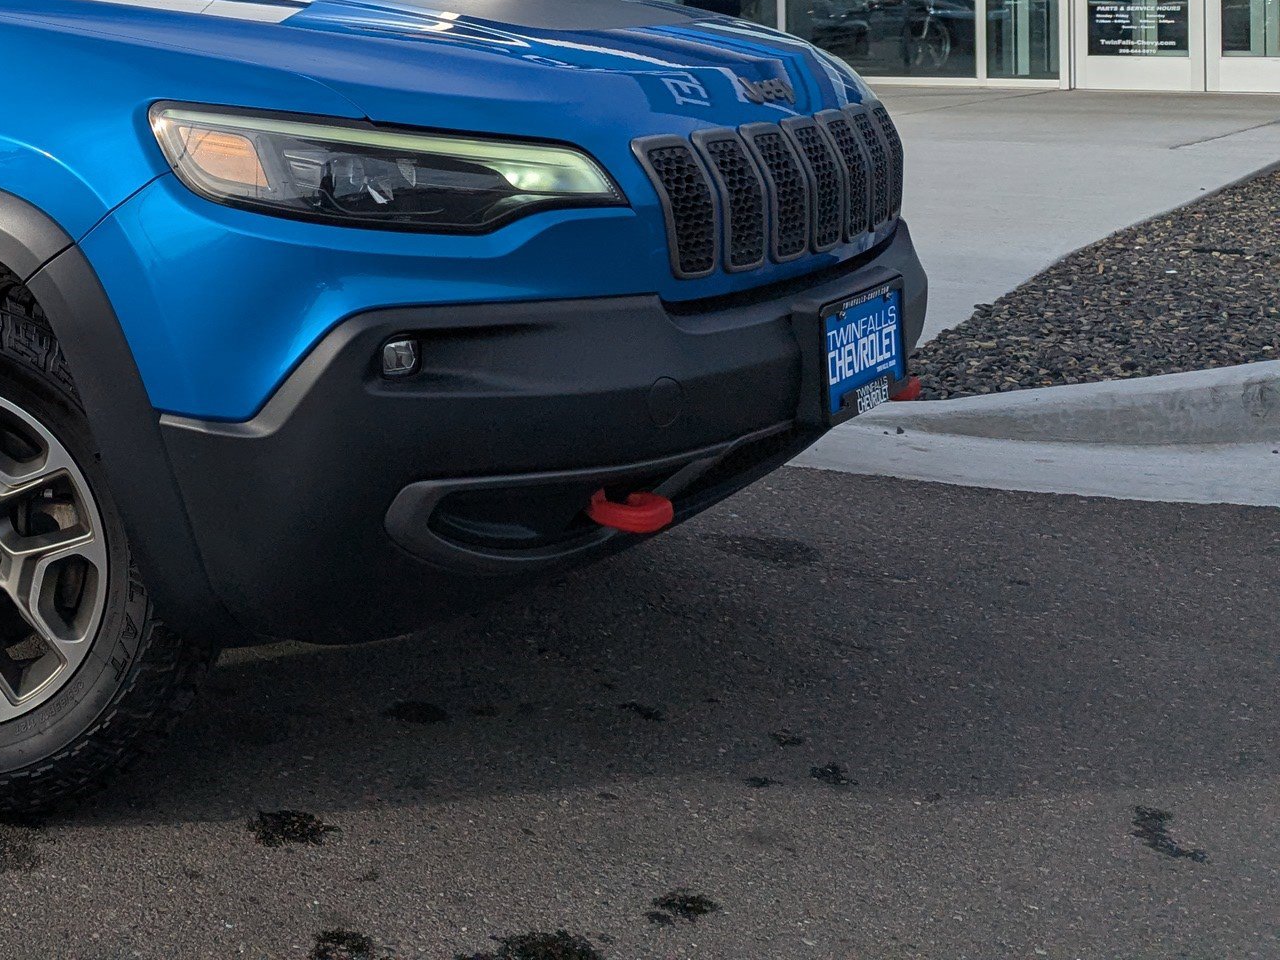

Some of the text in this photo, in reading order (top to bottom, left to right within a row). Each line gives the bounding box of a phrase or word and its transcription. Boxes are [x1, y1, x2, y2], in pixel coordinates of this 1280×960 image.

[738, 76, 796, 104] Jeep
[827, 305, 897, 351] TWINFALLS
[827, 324, 897, 386] CHEVROLET
